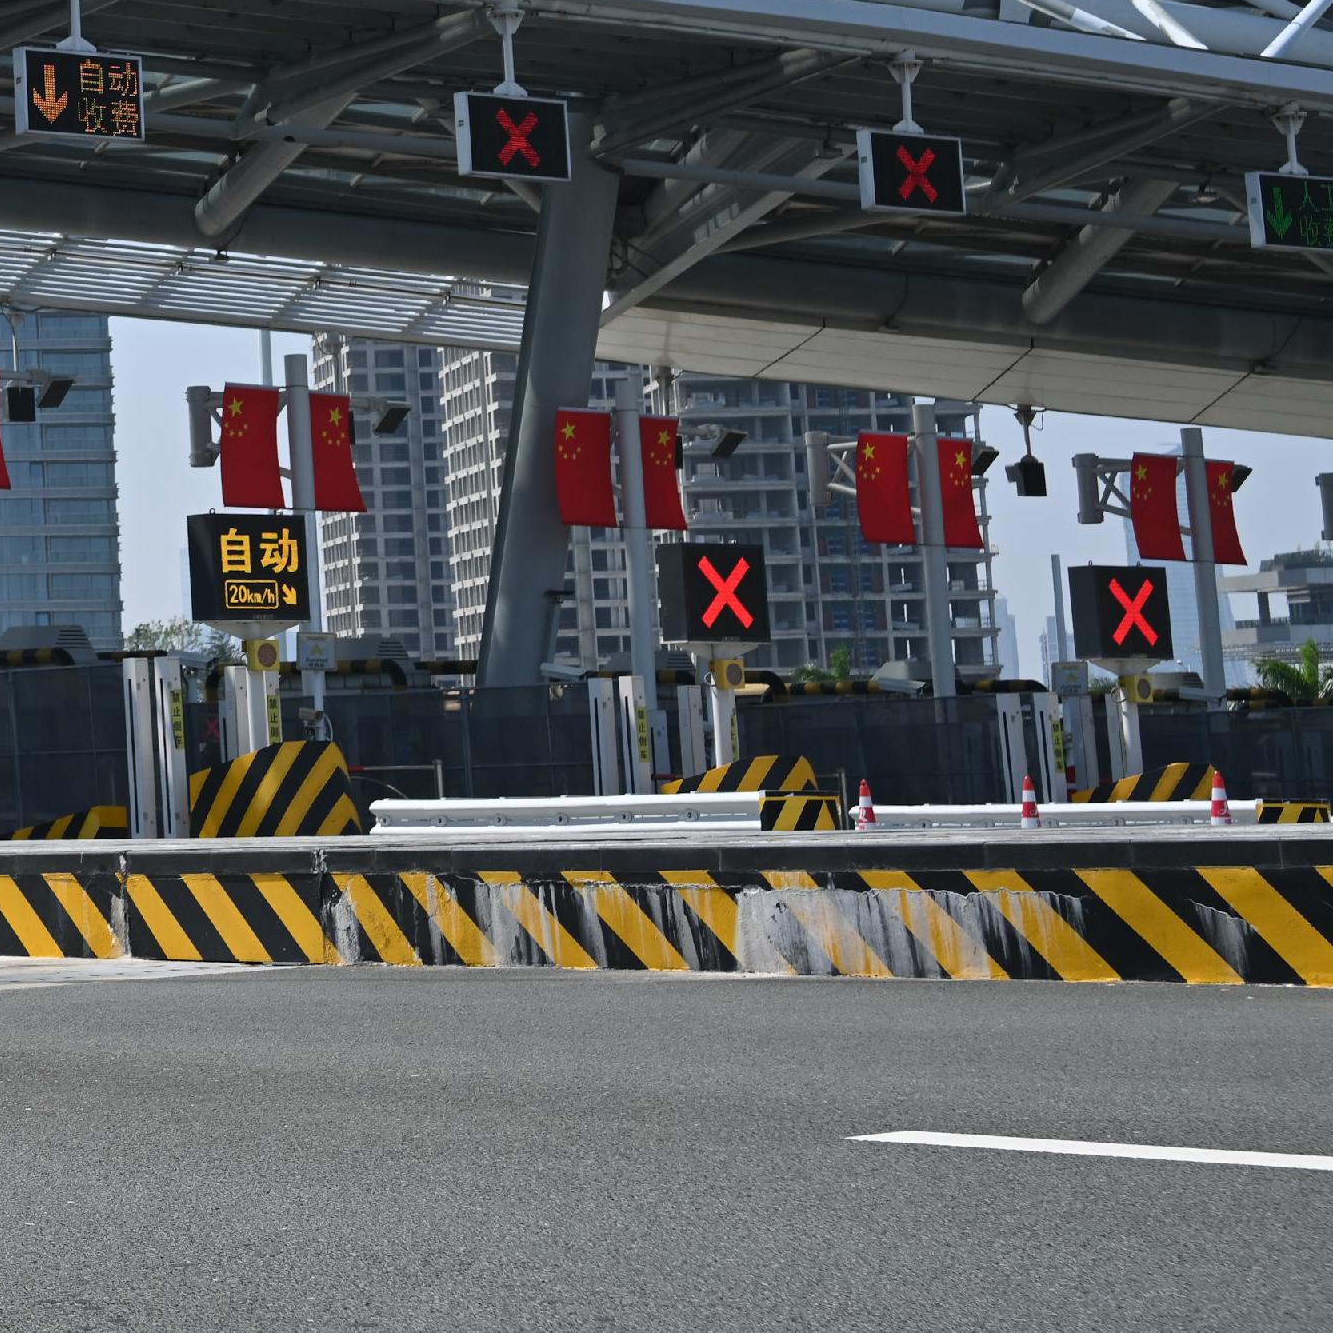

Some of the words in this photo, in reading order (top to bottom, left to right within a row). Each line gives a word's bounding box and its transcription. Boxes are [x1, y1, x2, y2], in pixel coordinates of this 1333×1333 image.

[79, 58, 137, 96] 自动
[78, 97, 138, 136] 收费
[220, 527, 299, 573] 自动
[229, 585, 275, 604] 20km/h
[269, 698, 279, 738] 禁止倒
